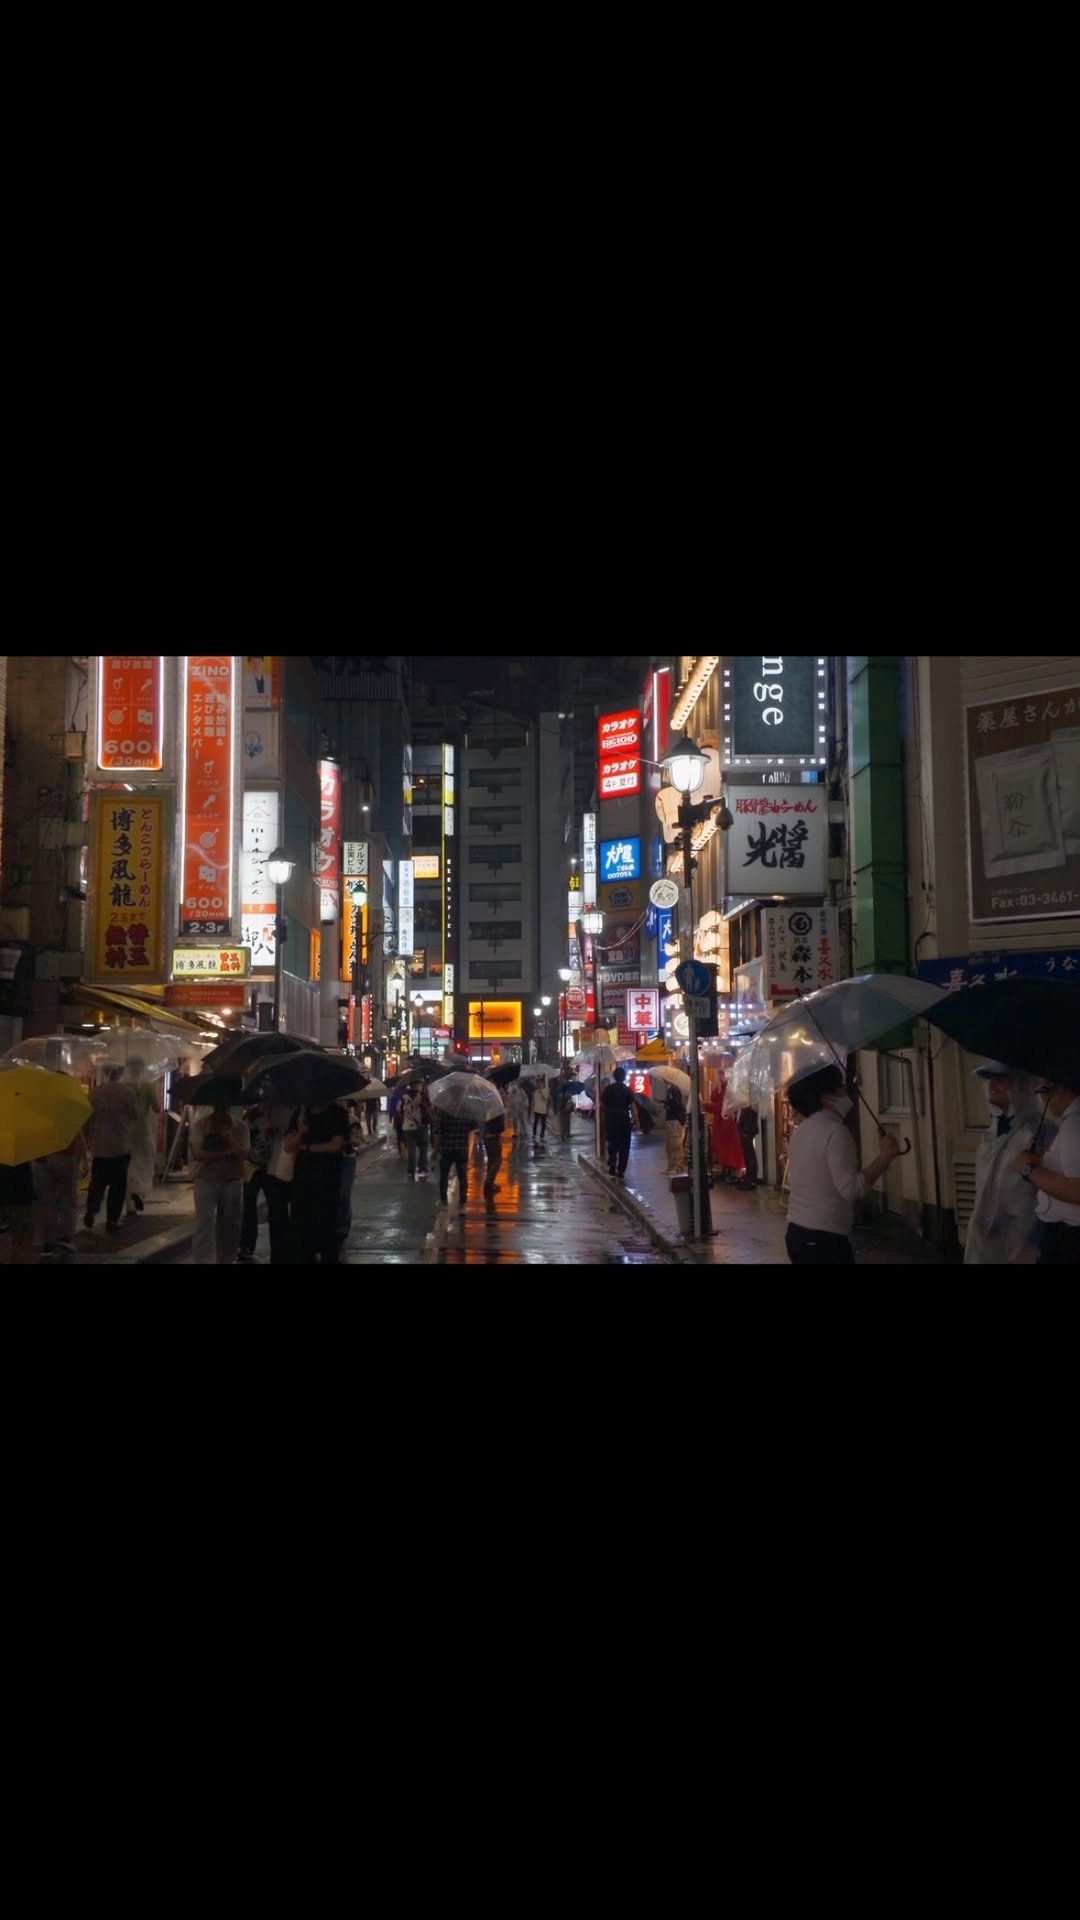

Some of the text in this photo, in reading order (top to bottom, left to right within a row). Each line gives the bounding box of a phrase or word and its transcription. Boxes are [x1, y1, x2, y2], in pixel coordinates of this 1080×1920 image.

[602, 718, 637, 733] カラオケ
[603, 759, 637, 774] カラオケ
[110, 808, 136, 907] 博多風龍
[139, 808, 152, 908] とんこつらーめん
[185, 896, 223, 909] 600
[634, 994, 652, 1026] 中華
